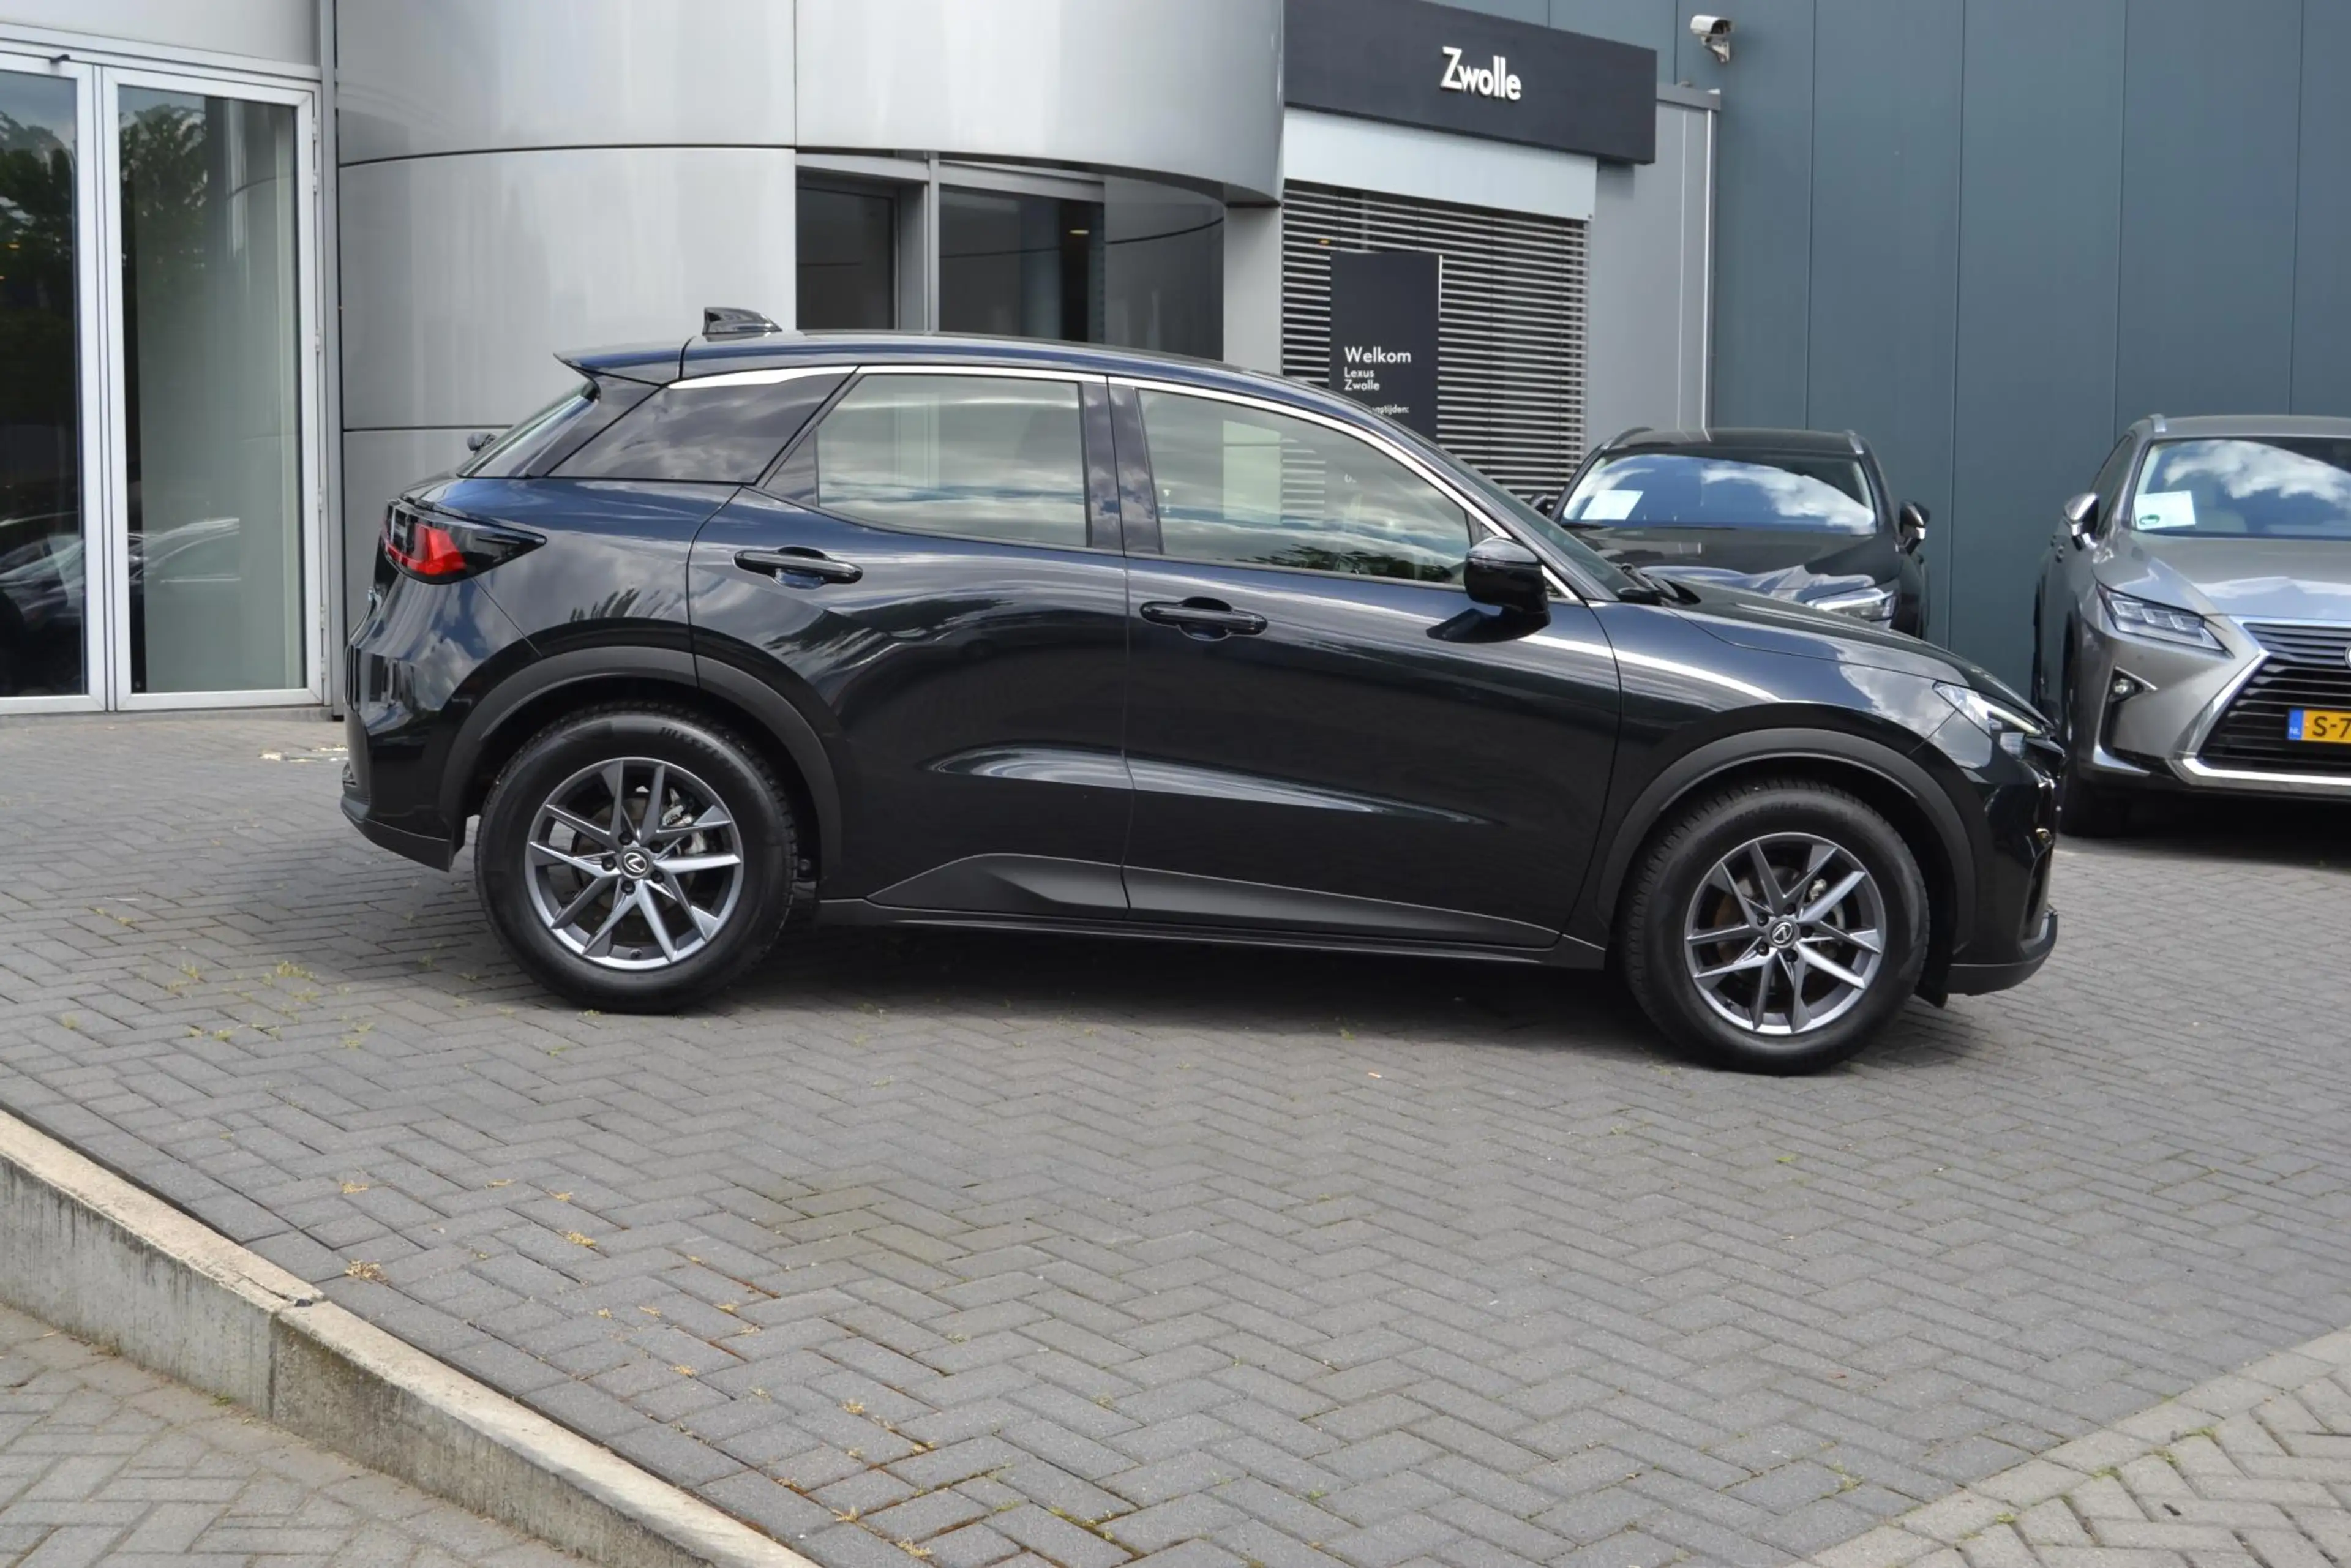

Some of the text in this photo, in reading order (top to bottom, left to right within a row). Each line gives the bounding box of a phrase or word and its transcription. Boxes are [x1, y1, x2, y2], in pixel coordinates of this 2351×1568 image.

[1441, 46, 1521, 100] Zwolle
[1344, 346, 1411, 363] Welkom
[1344, 367, 1374, 378] Lexus
[1344, 379, 1380, 391] Zwolle
